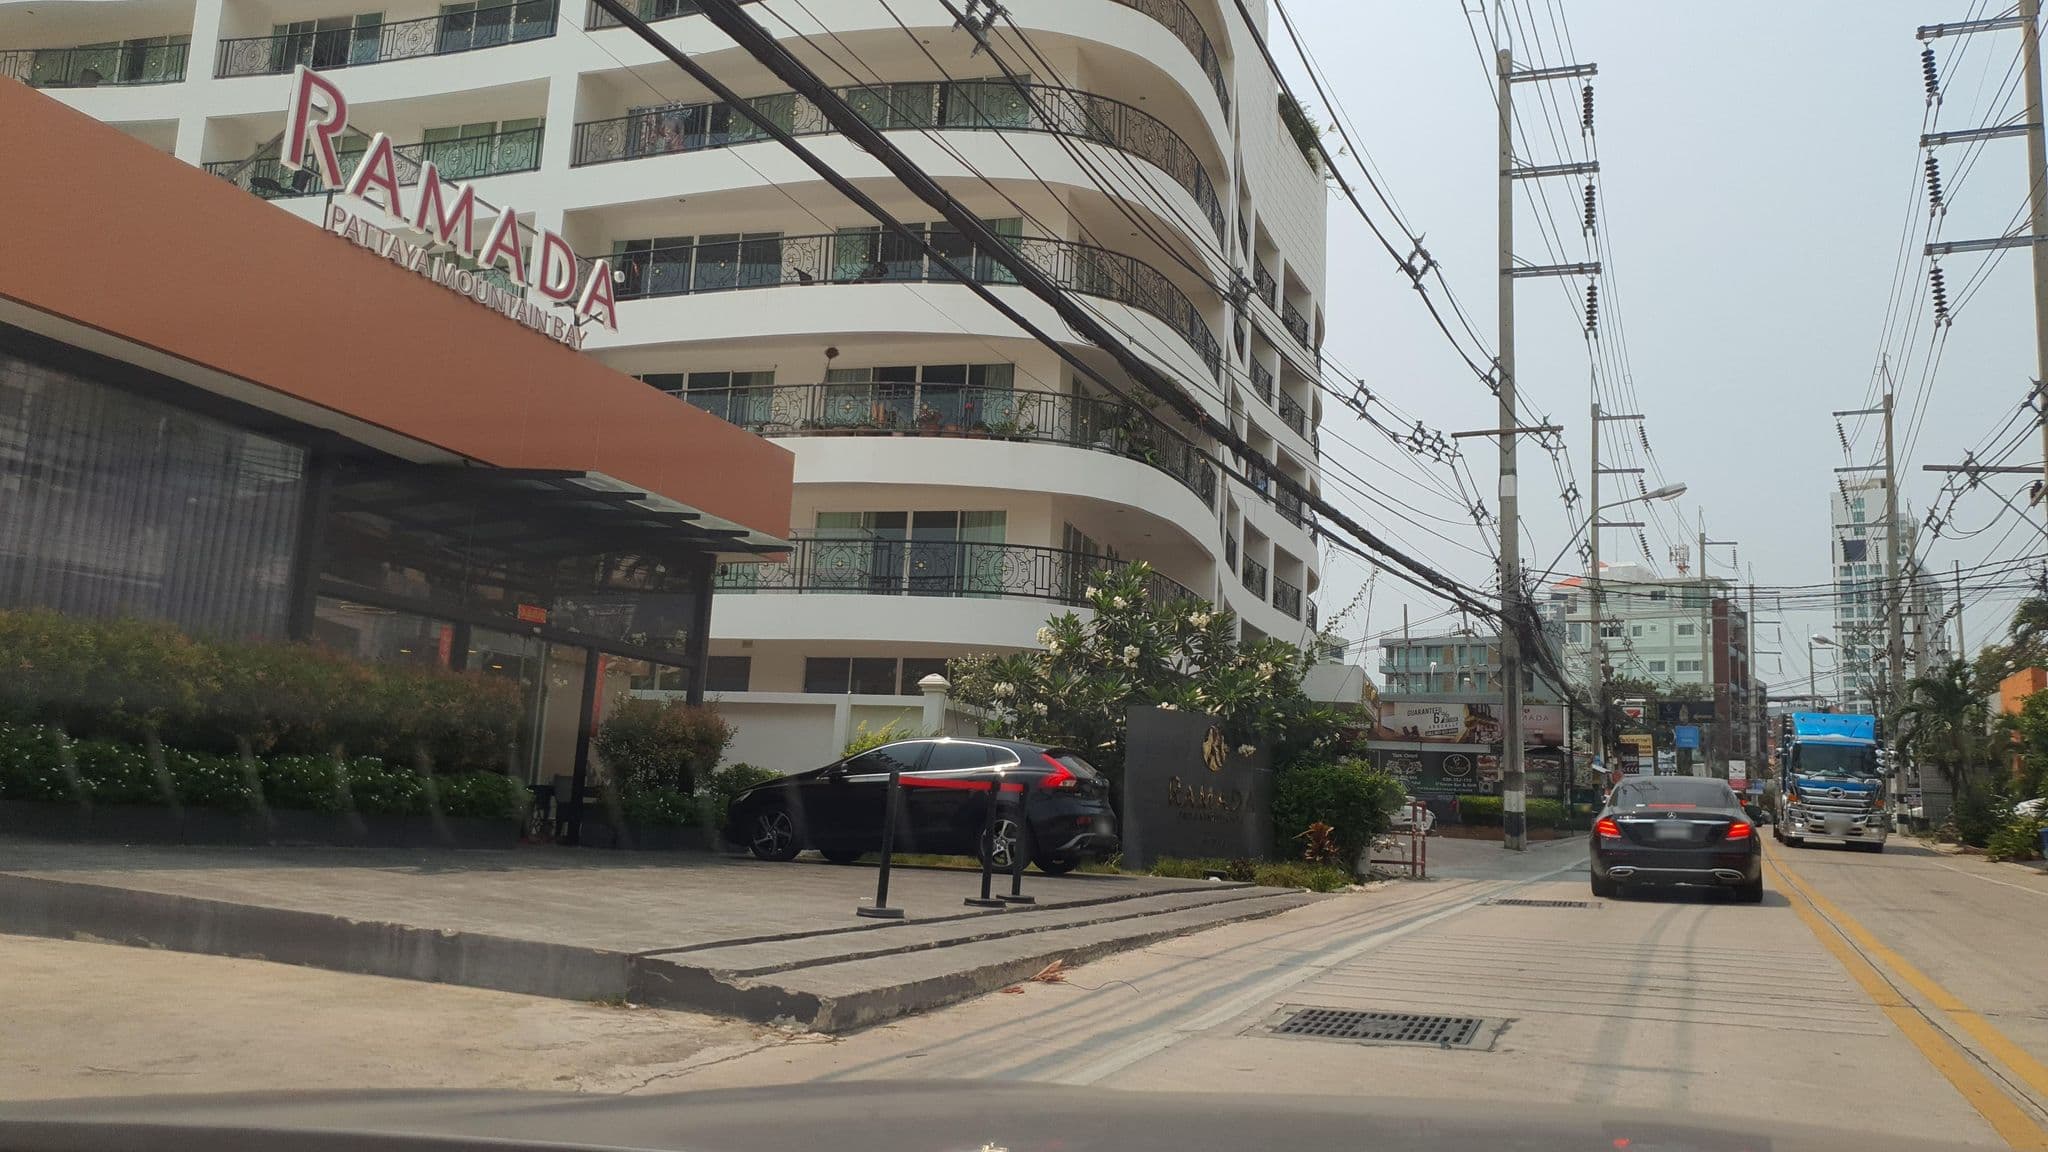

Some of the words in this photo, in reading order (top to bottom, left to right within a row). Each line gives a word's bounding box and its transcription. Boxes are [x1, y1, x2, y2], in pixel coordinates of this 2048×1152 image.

[281, 64, 618, 334] RAMADA
[327, 203, 431, 278] PATTAYA
[432, 256, 549, 334] MOUNTAIN
[550, 314, 588, 350] BAY
